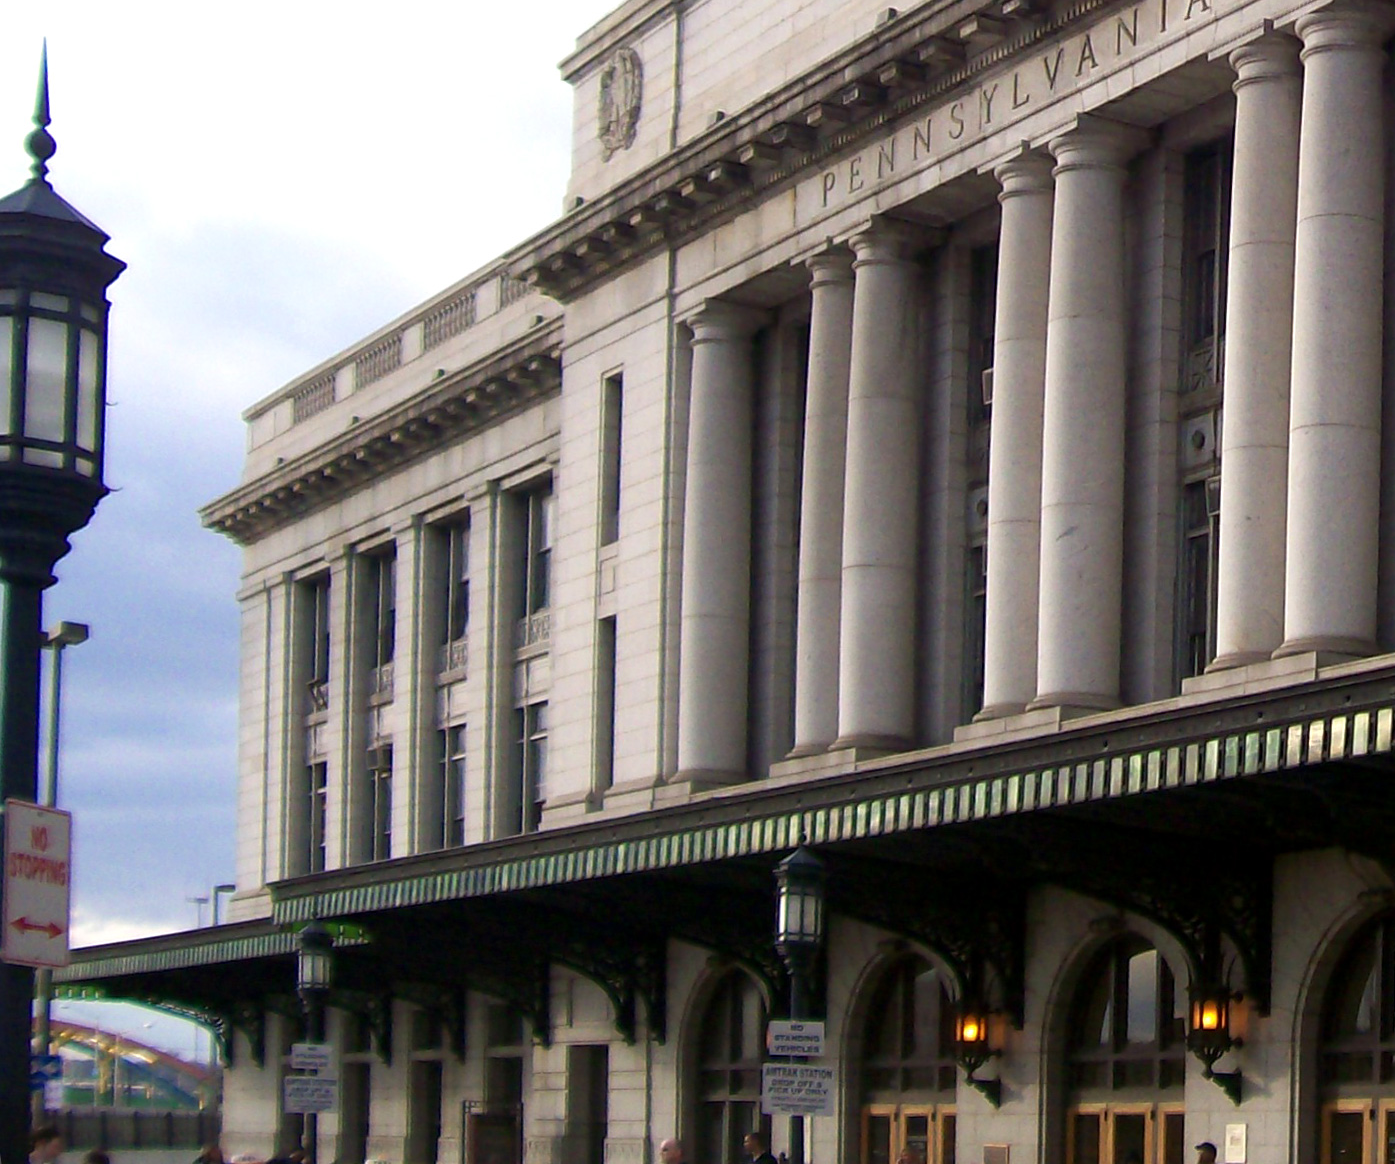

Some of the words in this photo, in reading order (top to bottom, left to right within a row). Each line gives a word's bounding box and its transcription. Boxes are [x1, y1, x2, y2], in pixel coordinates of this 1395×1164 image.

[31, 825, 48, 852] NO
[9, 852, 66, 887] STOPPING
[790, 1024, 804, 1032] NO
